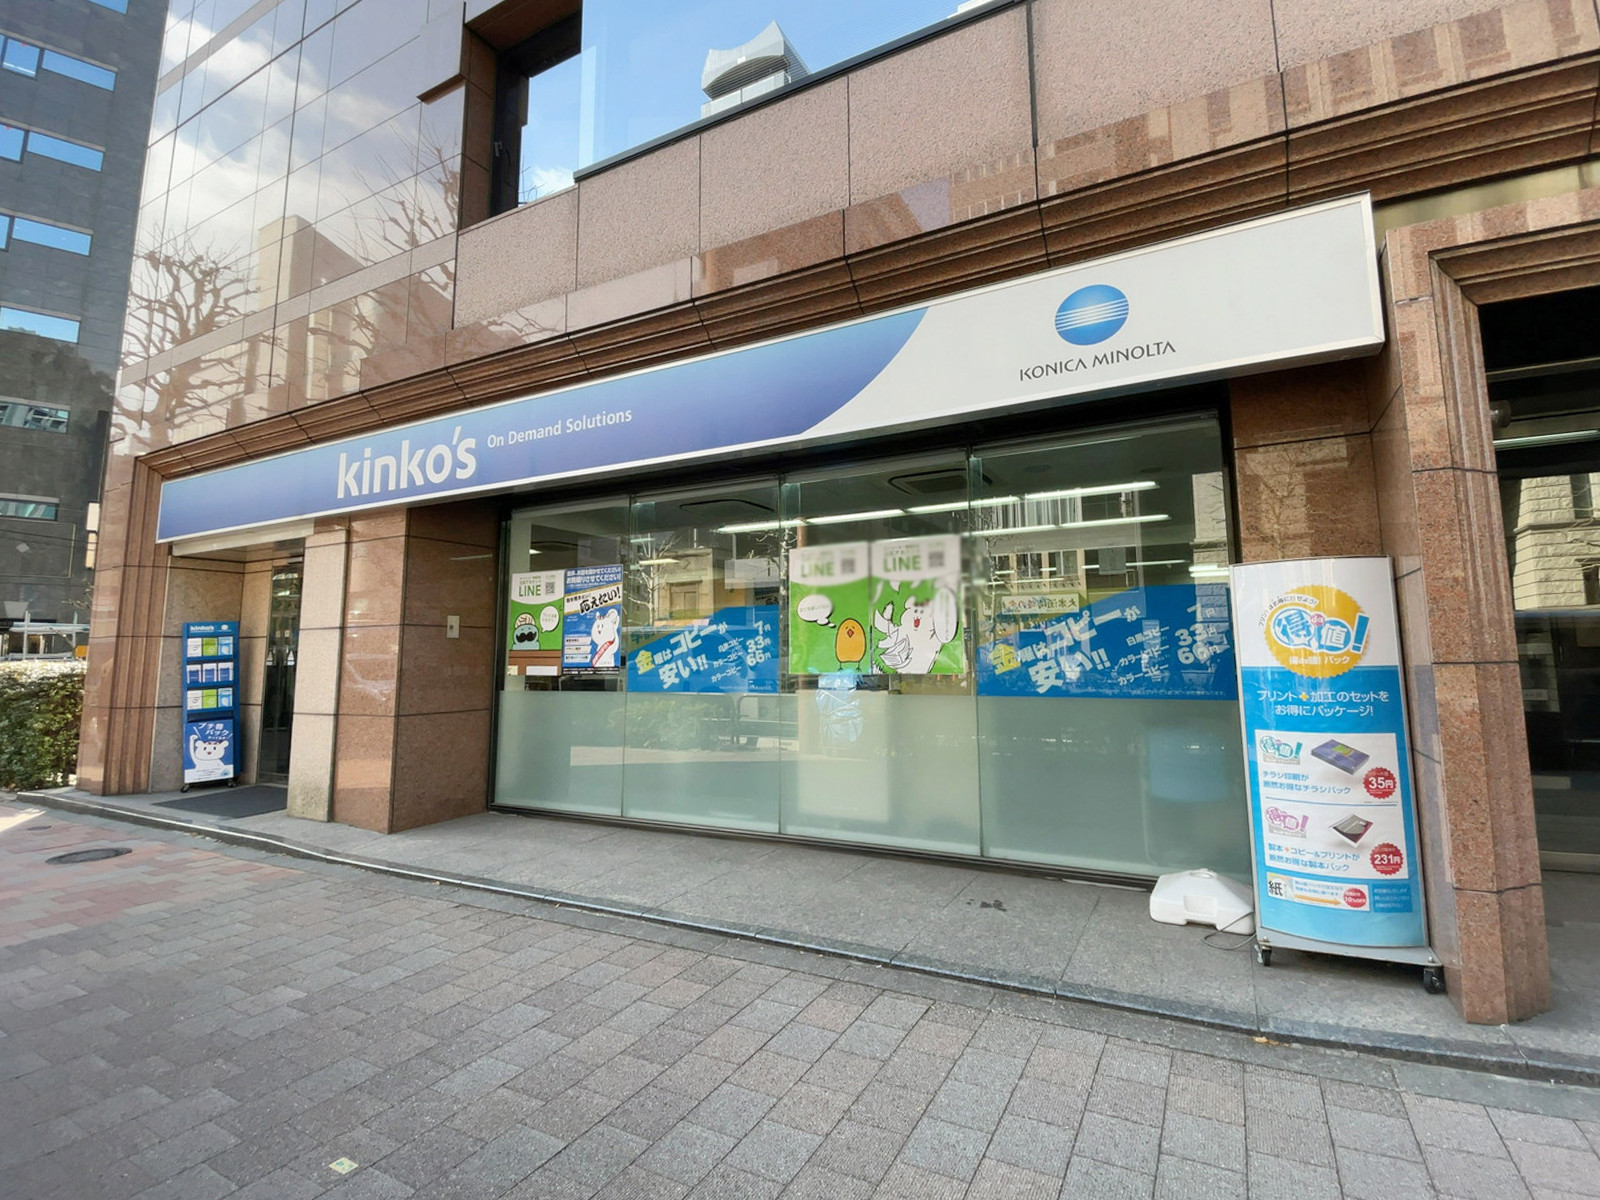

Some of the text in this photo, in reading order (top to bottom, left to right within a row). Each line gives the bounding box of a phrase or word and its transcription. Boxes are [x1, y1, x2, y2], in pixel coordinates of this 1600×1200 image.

[1020, 341, 1176, 381] KONICA MINOLTA
[487, 410, 632, 449] On Demand Solutions
[337, 425, 476, 499] kinko's
[801, 562, 835, 579] LINE
[884, 555, 921, 573] LINE
[518, 585, 541, 597] LINE
[1368, 776, 1394, 789] 35円
[1374, 854, 1401, 865] 231円
[1268, 880, 1283, 897] 紙
